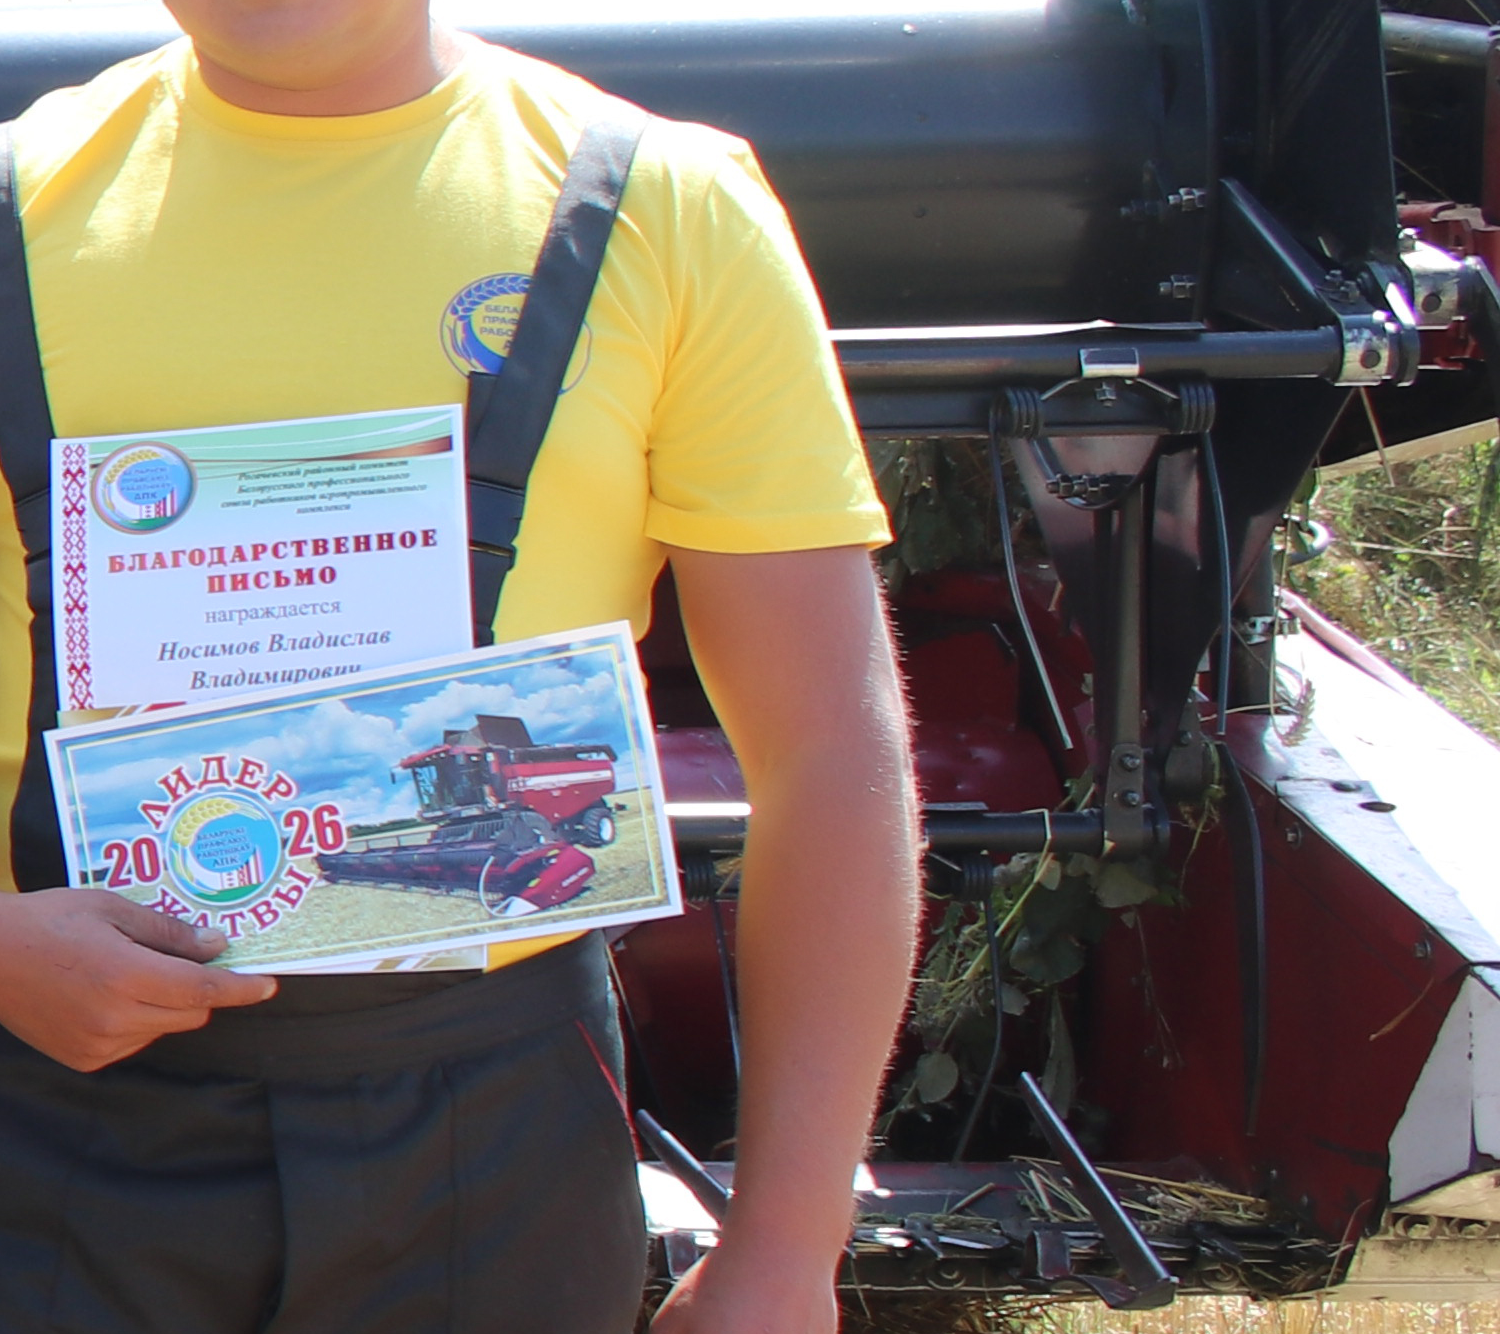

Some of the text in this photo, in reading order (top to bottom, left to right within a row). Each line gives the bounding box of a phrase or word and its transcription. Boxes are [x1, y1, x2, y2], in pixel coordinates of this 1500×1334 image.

[107, 529, 438, 574] БЛАГОДАРСТВЕННОЕ
[206, 566, 338, 594] ПИСЬМО
[204, 600, 342, 626] награждается
[157, 629, 392, 662] Носимов Владислав
[140, 755, 295, 830] ЛИДЕР
[103, 804, 344, 888] 20 26
[212, 855, 240, 867] АПК
